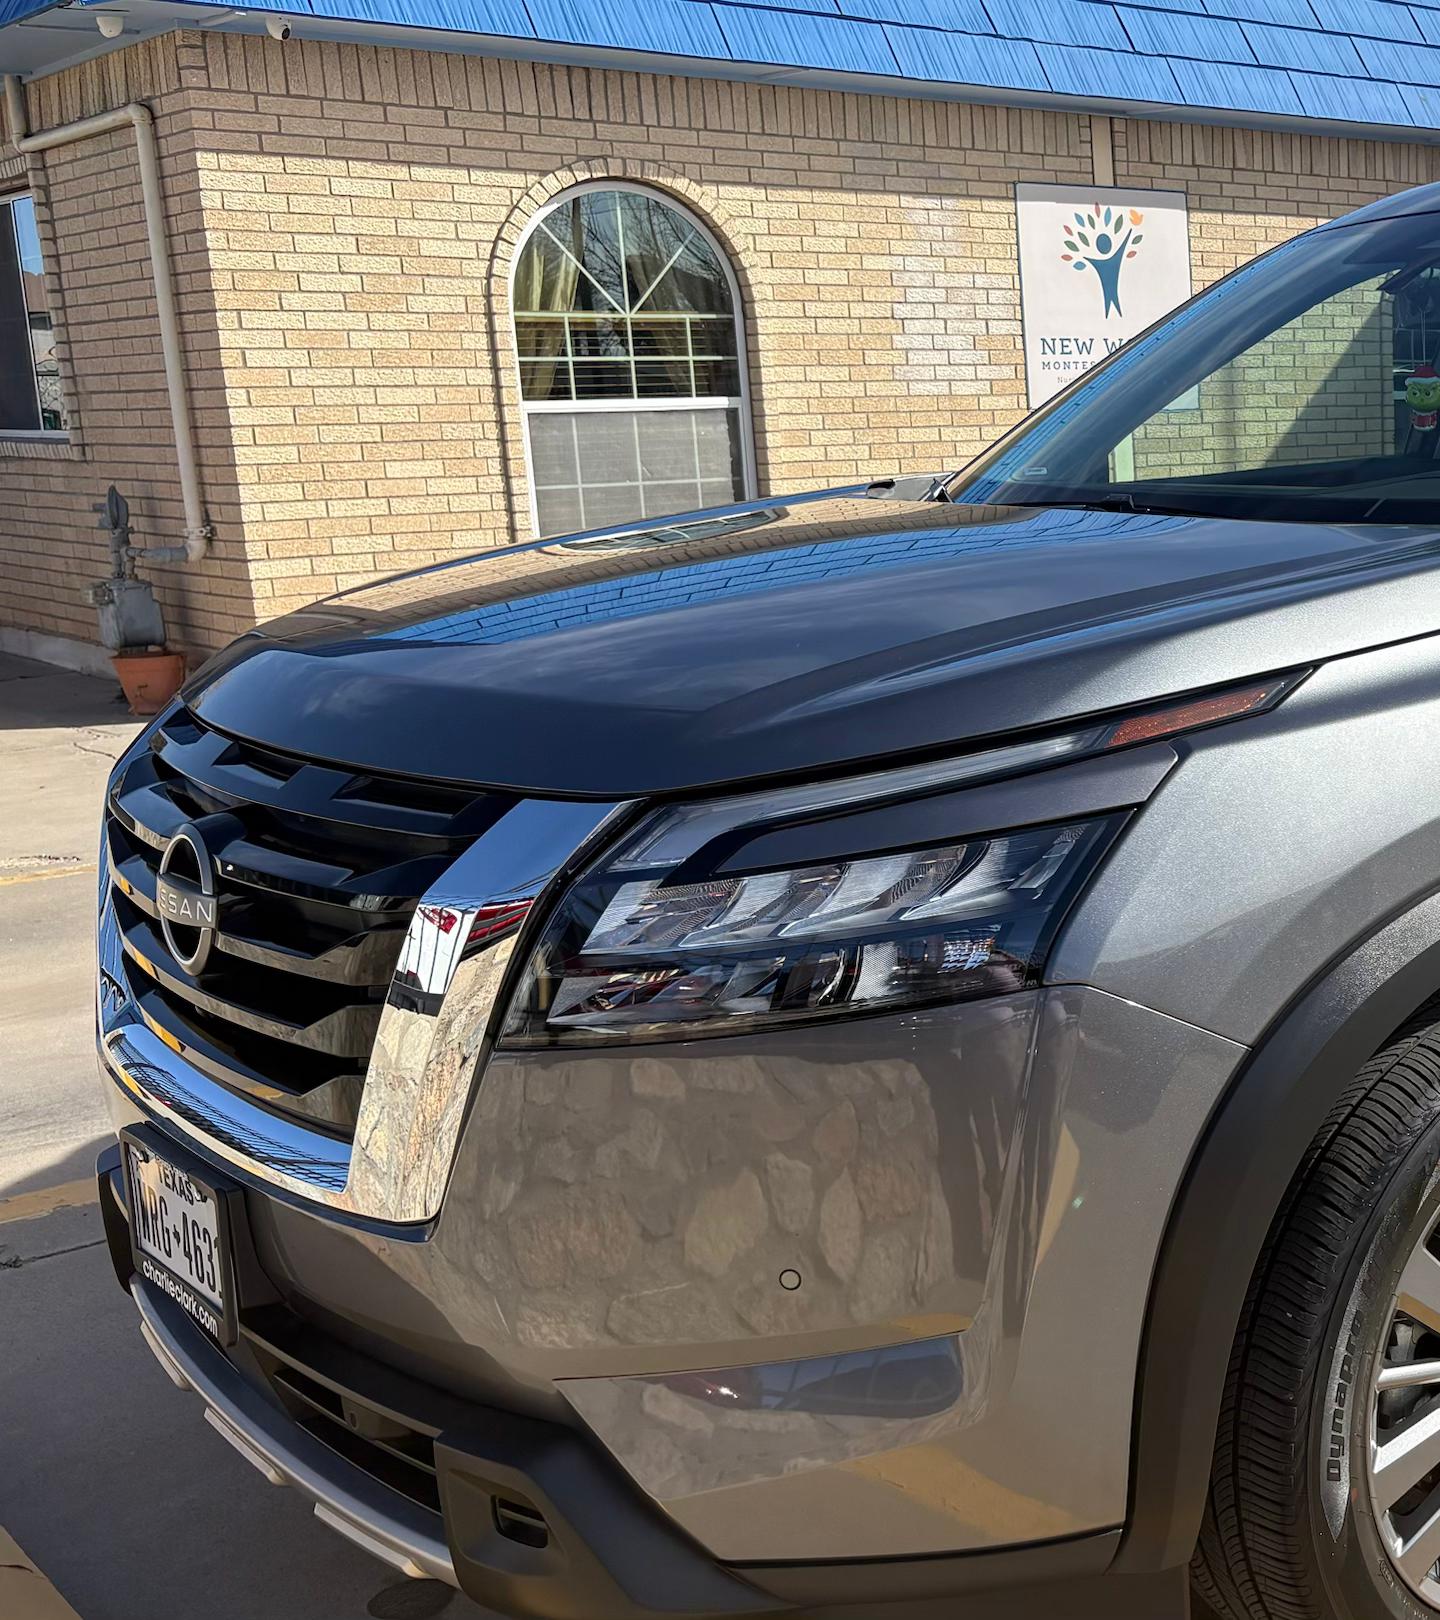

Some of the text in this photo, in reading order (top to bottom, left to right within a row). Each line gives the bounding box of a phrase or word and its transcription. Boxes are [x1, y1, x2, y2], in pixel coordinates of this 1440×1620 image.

[1040, 338, 1094, 355] NEW
[156, 1161, 194, 1206] TEXAS
[142, 1259, 219, 1338] charlieclark.com
